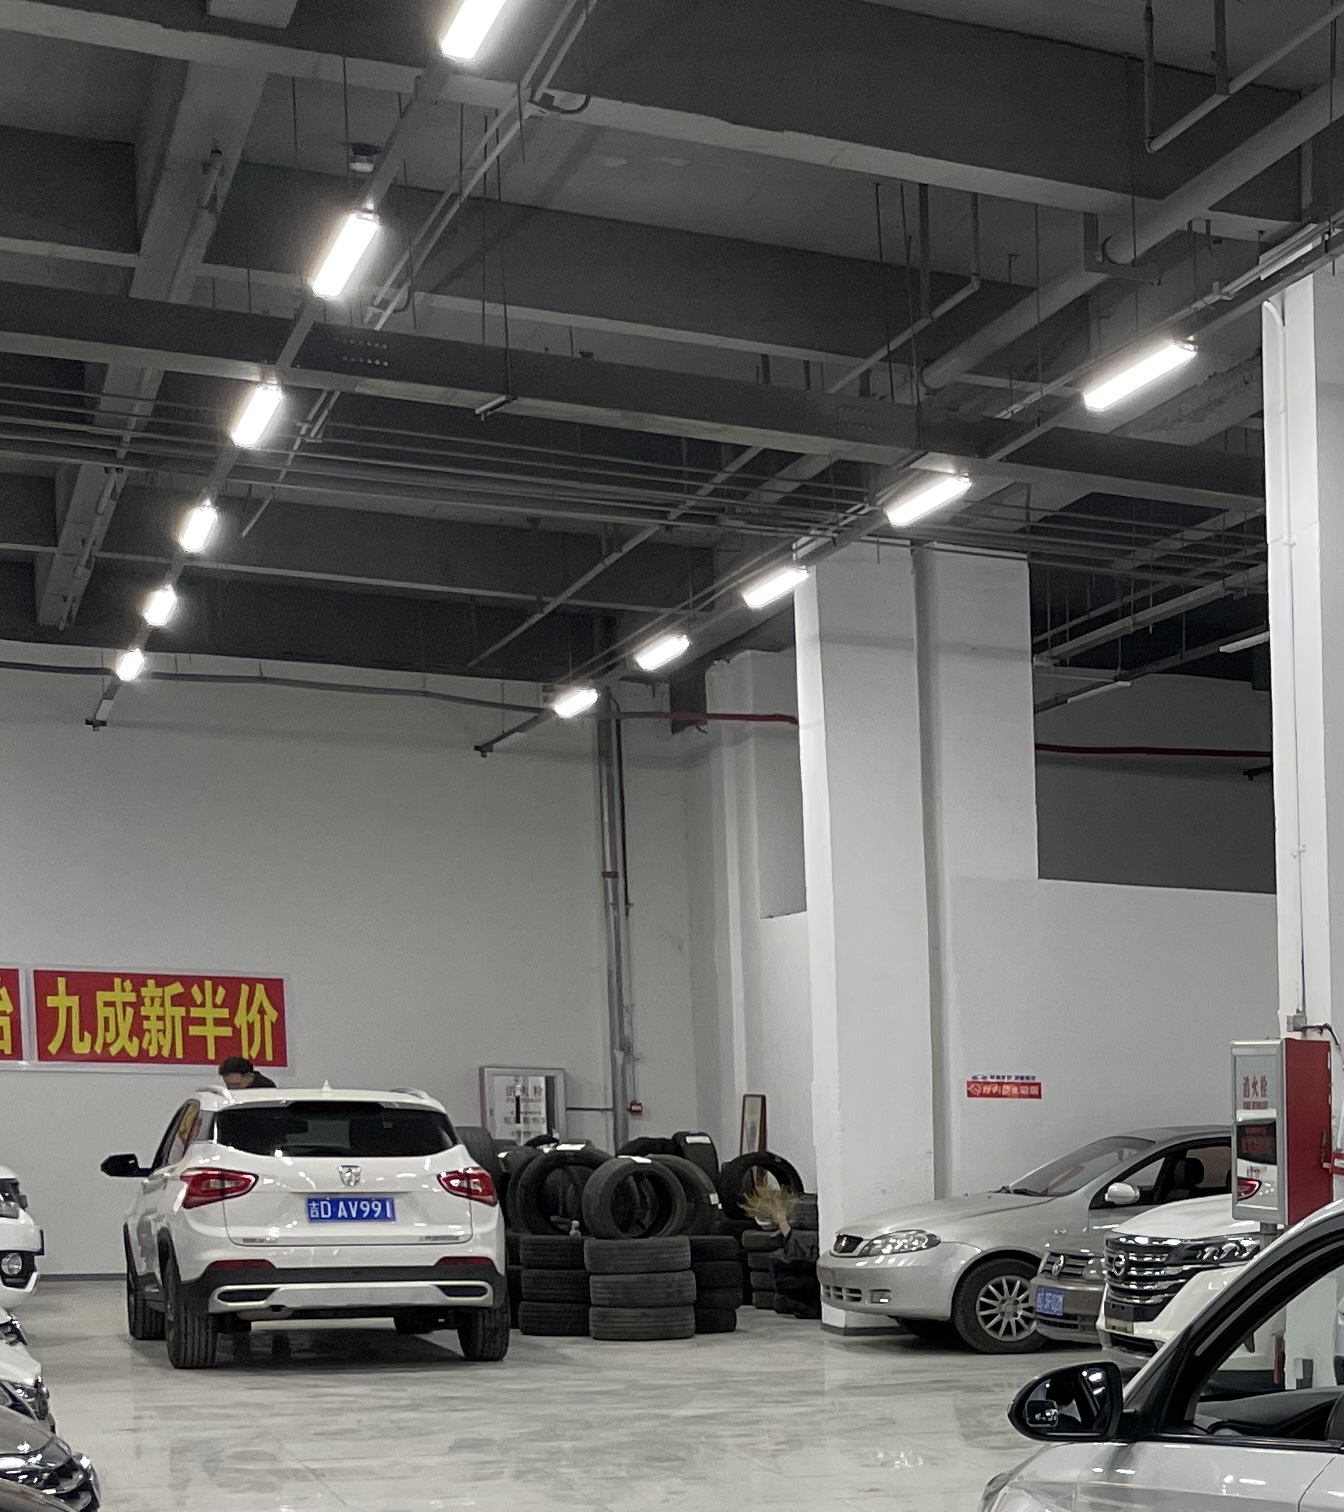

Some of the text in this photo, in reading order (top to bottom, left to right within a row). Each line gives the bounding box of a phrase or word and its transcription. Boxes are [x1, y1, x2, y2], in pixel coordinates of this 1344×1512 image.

[47, 977, 279, 1061] 九成新半价
